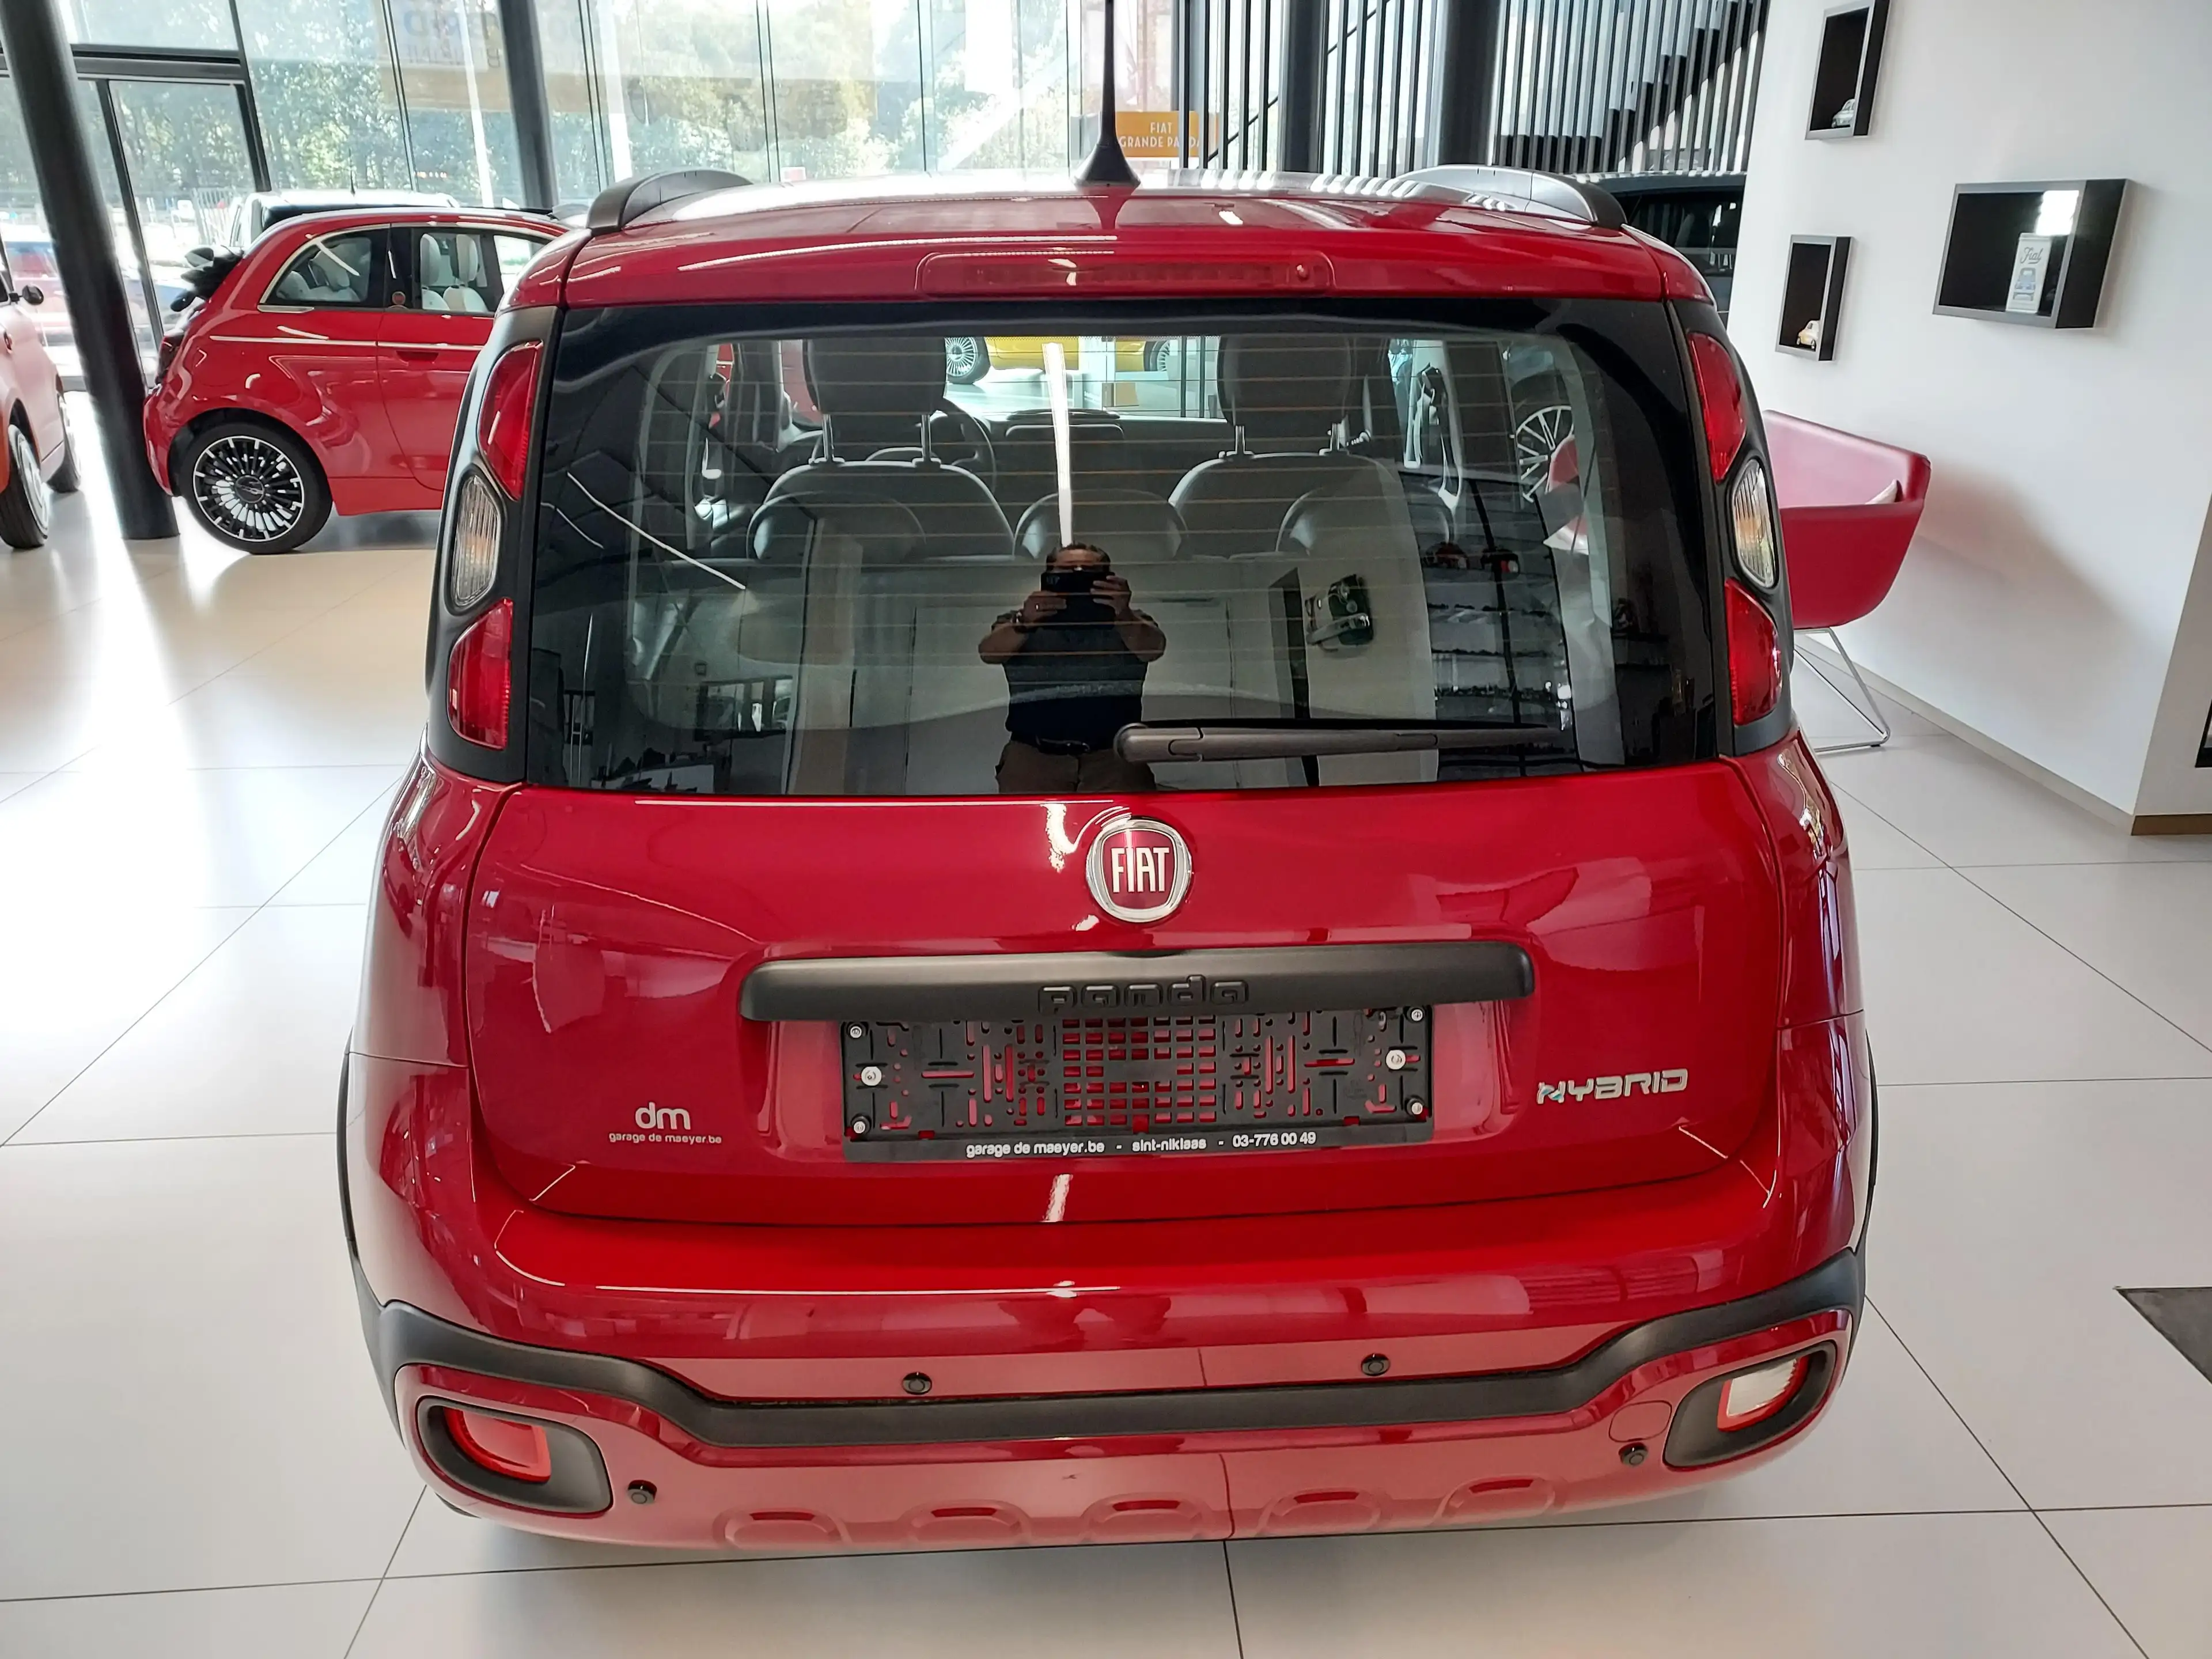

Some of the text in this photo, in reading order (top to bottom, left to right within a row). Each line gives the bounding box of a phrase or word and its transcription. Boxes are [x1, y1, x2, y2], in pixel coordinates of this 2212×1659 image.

[1119, 135, 1200, 148] GRANDE PAD
[1150, 122, 1173, 134] FIAT
[1111, 846, 1170, 893] FIAT
[1038, 974, 1249, 1015] panda
[1536, 1068, 1688, 1105] HYBRID
[635, 1101, 691, 1130] dm
[608, 1132, 722, 1145] garage de maeyer.be
[966, 1143, 1011, 1158] garage
[1014, 1141, 1031, 1154] de
[1033, 1140, 1105, 1156] maeyer.be
[1132, 1138, 1207, 1152] sint-niklaas
[1232, 1134, 1278, 1147] 03-776
[1280, 1132, 1297, 1146] 00
[1300, 1131, 1316, 1145] 49
